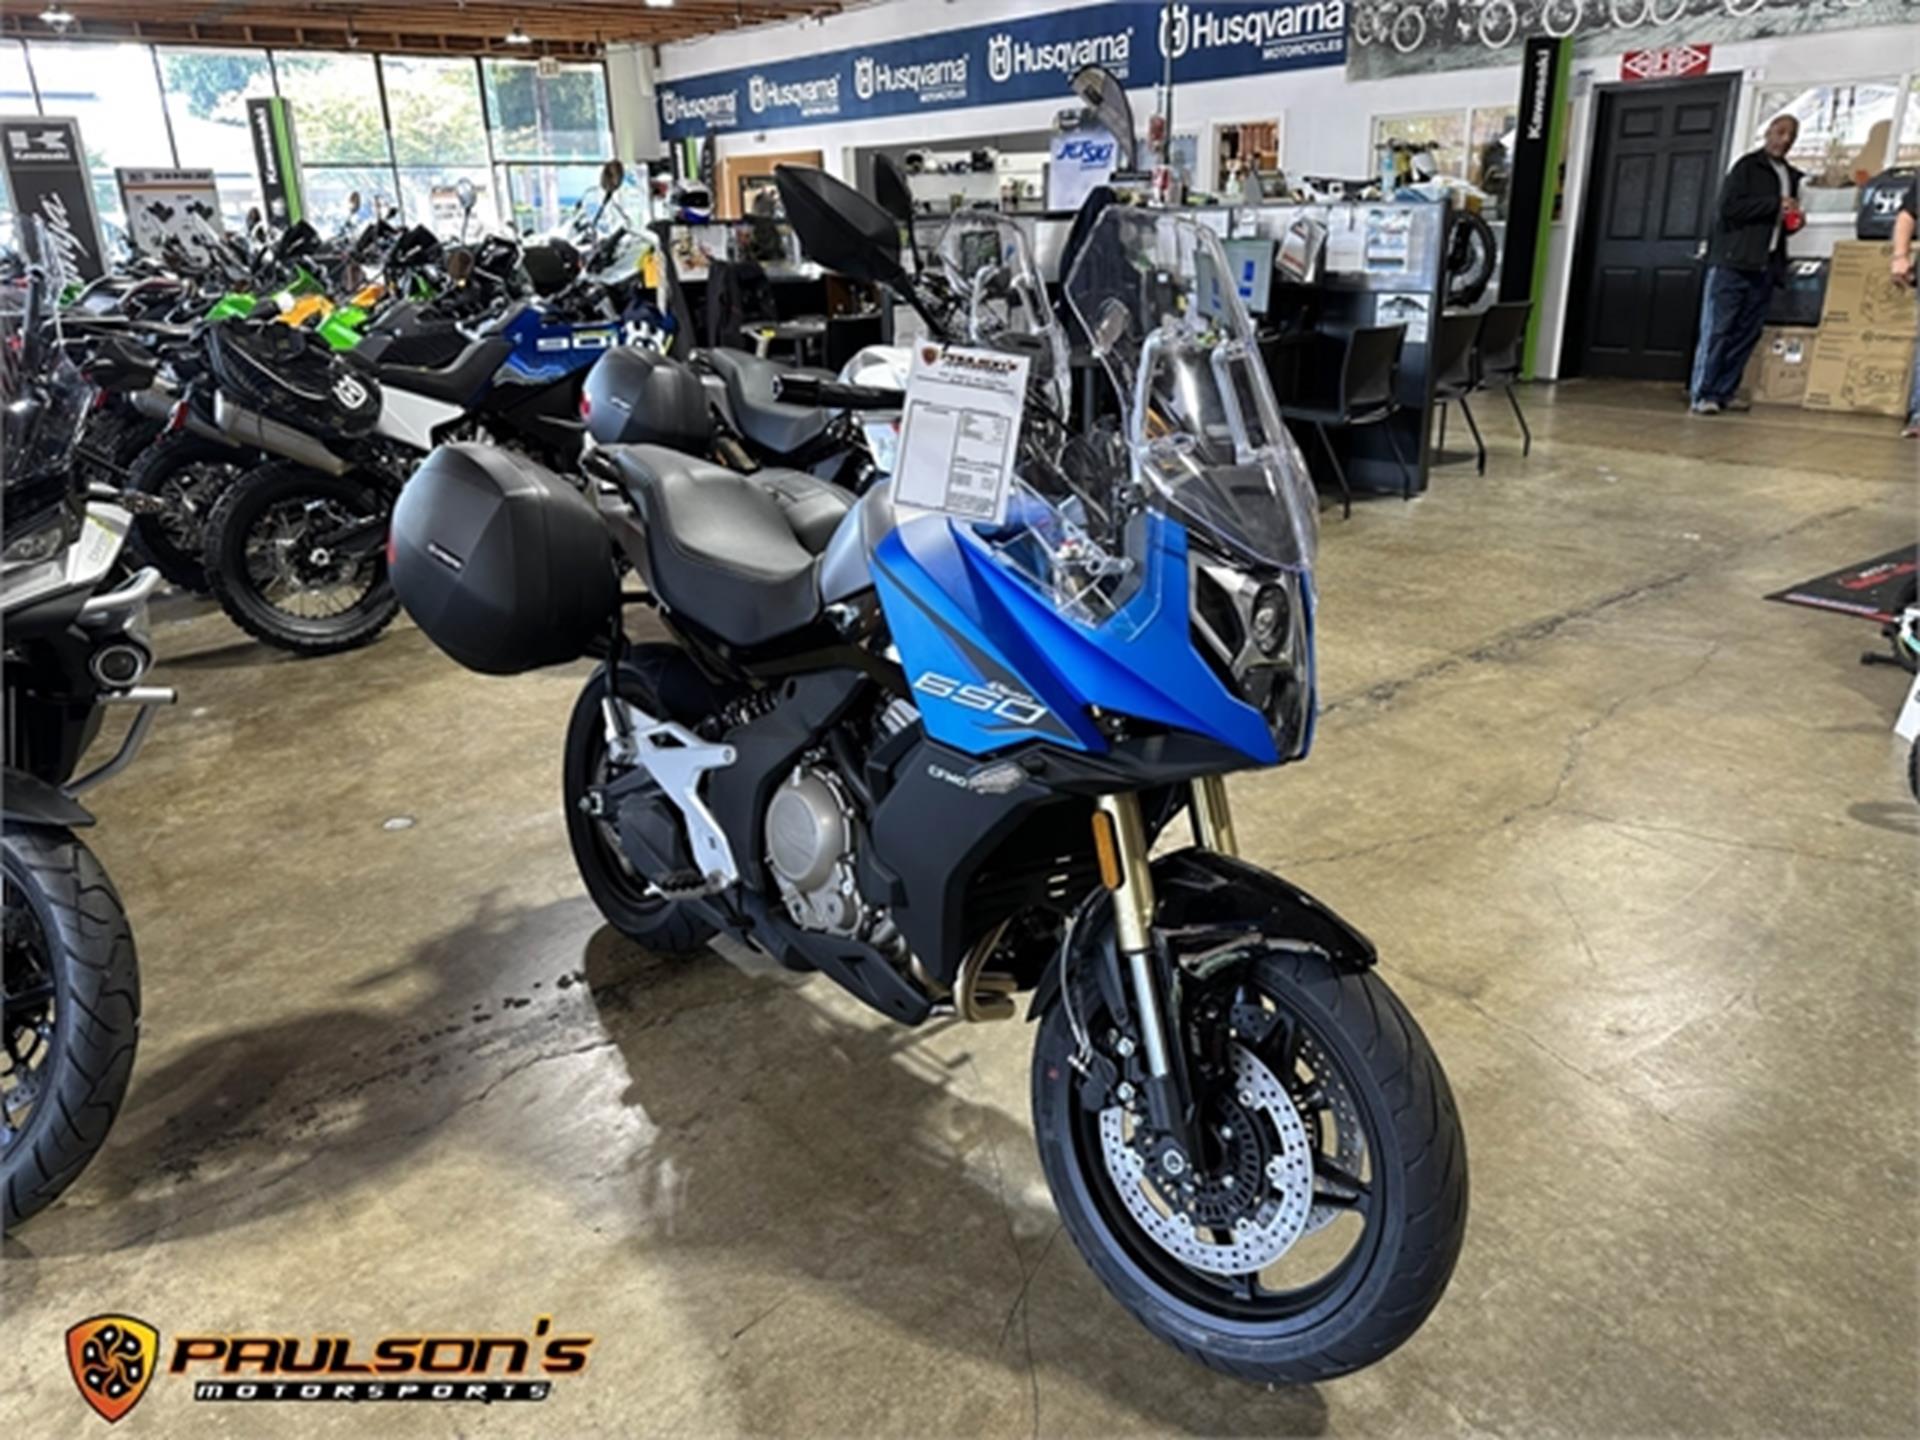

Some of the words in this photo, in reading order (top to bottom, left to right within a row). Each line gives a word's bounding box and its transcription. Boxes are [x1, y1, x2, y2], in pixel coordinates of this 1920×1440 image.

[1192, 0, 1345, 48] Husqvarna
[1013, 33, 1129, 73] Husqvarna
[1262, 39, 1344, 60] MOTORCYCLES
[765, 79, 838, 107] Husqvarna
[875, 60, 967, 92] Husqvarna
[1527, 49, 1550, 139] Kawasaki
[254, 107, 279, 184] Kawasaki
[913, 671, 1049, 725] 650
